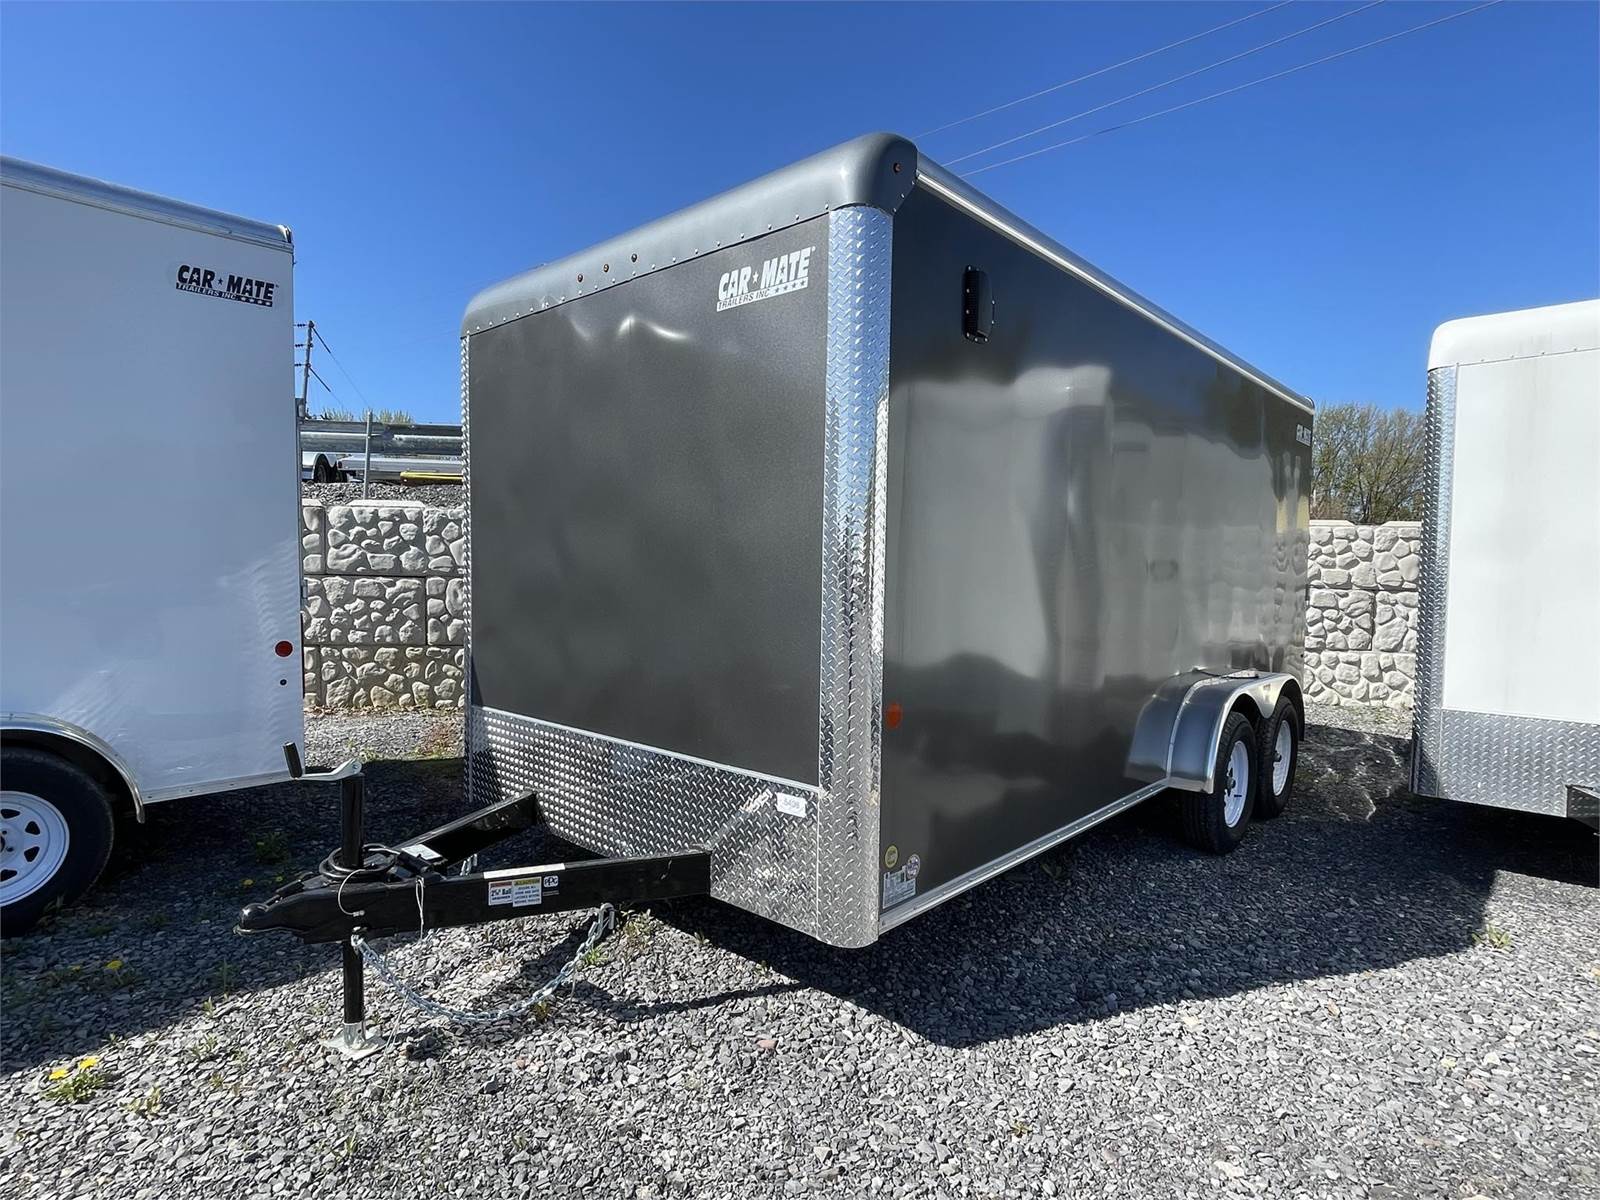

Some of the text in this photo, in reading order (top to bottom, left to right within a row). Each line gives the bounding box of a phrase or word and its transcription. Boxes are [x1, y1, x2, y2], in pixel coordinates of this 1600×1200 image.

[177, 264, 275, 300] CAR MATE
[718, 247, 811, 300] CAR MATE
[177, 283, 220, 298] TRAILERS
[718, 293, 754, 309] TRAILERS
